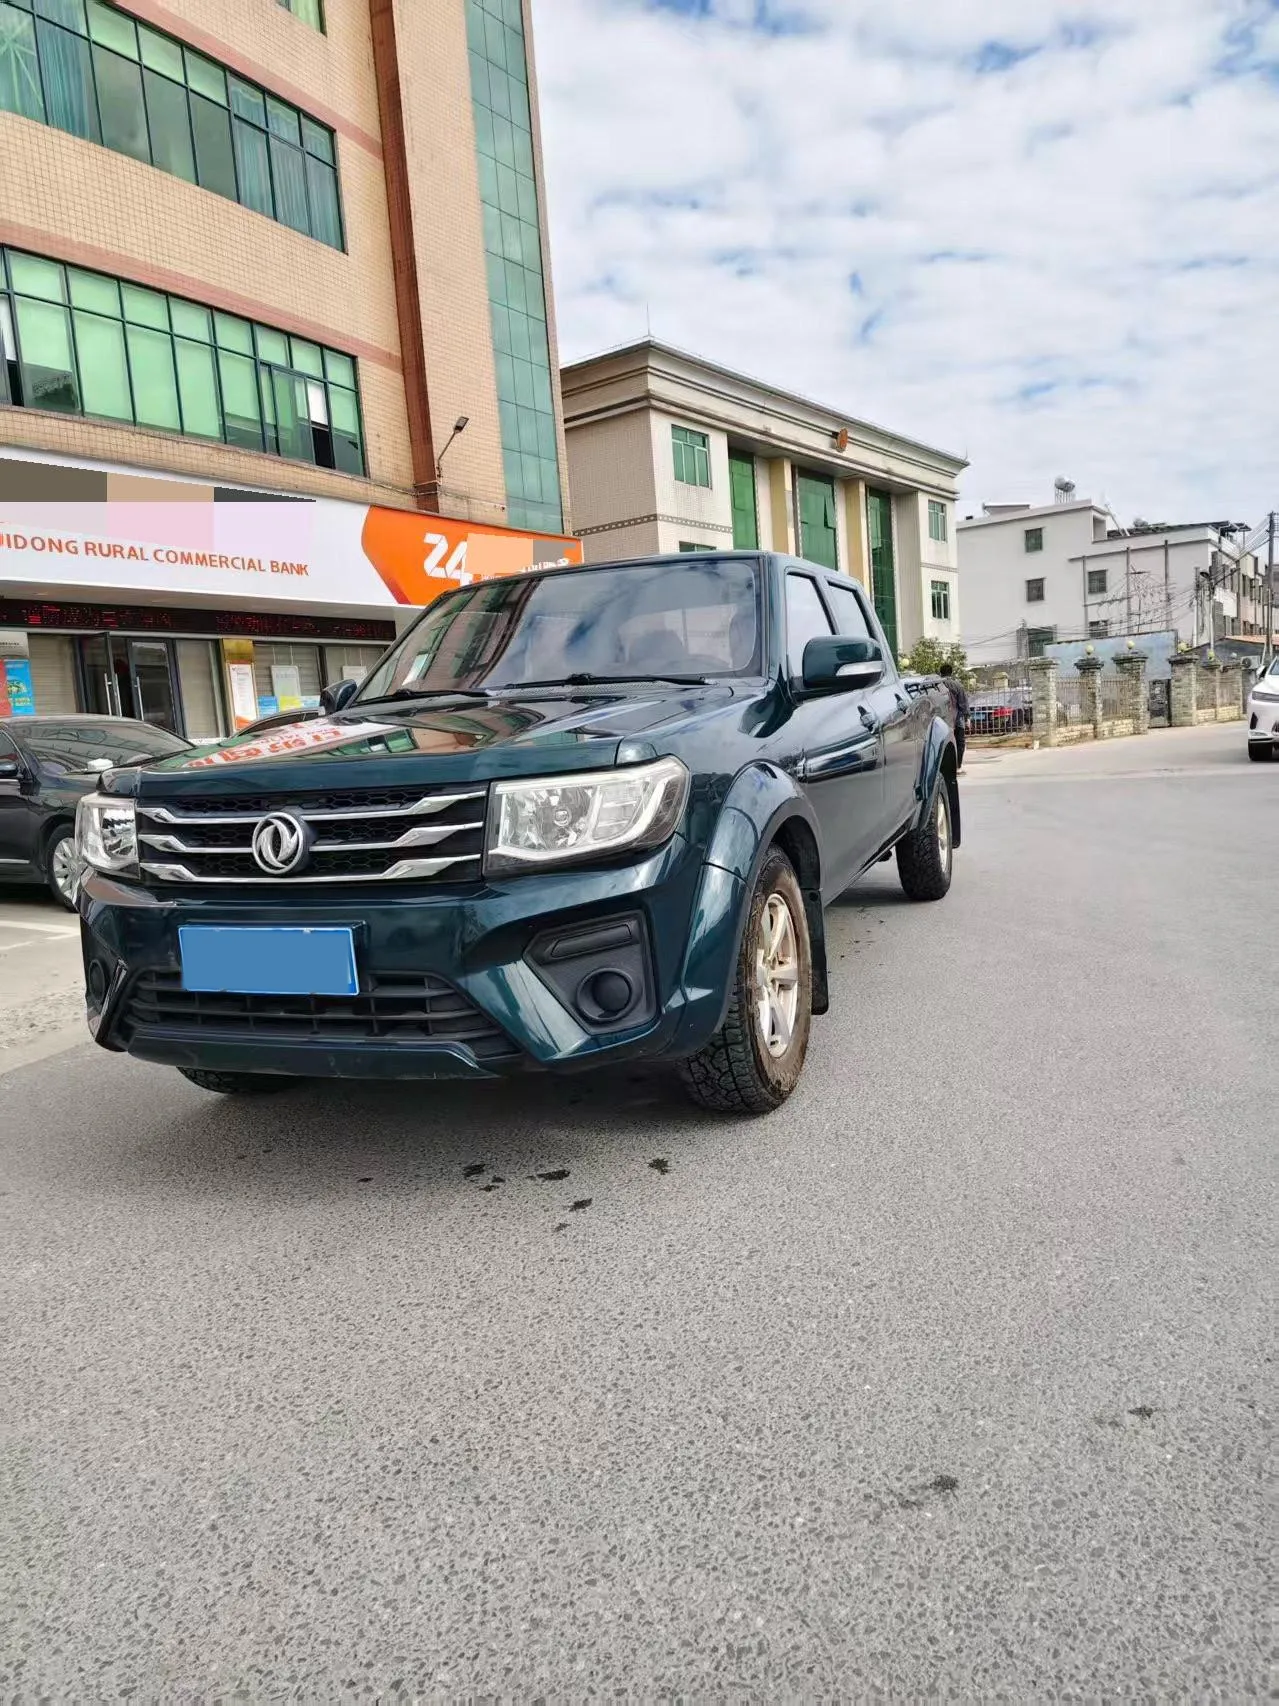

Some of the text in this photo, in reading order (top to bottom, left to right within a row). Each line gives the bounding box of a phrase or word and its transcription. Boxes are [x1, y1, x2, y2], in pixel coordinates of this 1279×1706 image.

[84, 541, 149, 561] RURAL
[153, 549, 266, 572] COMMERCIAL
[270, 560, 309, 576] BANK
[423, 532, 473, 587] 24
